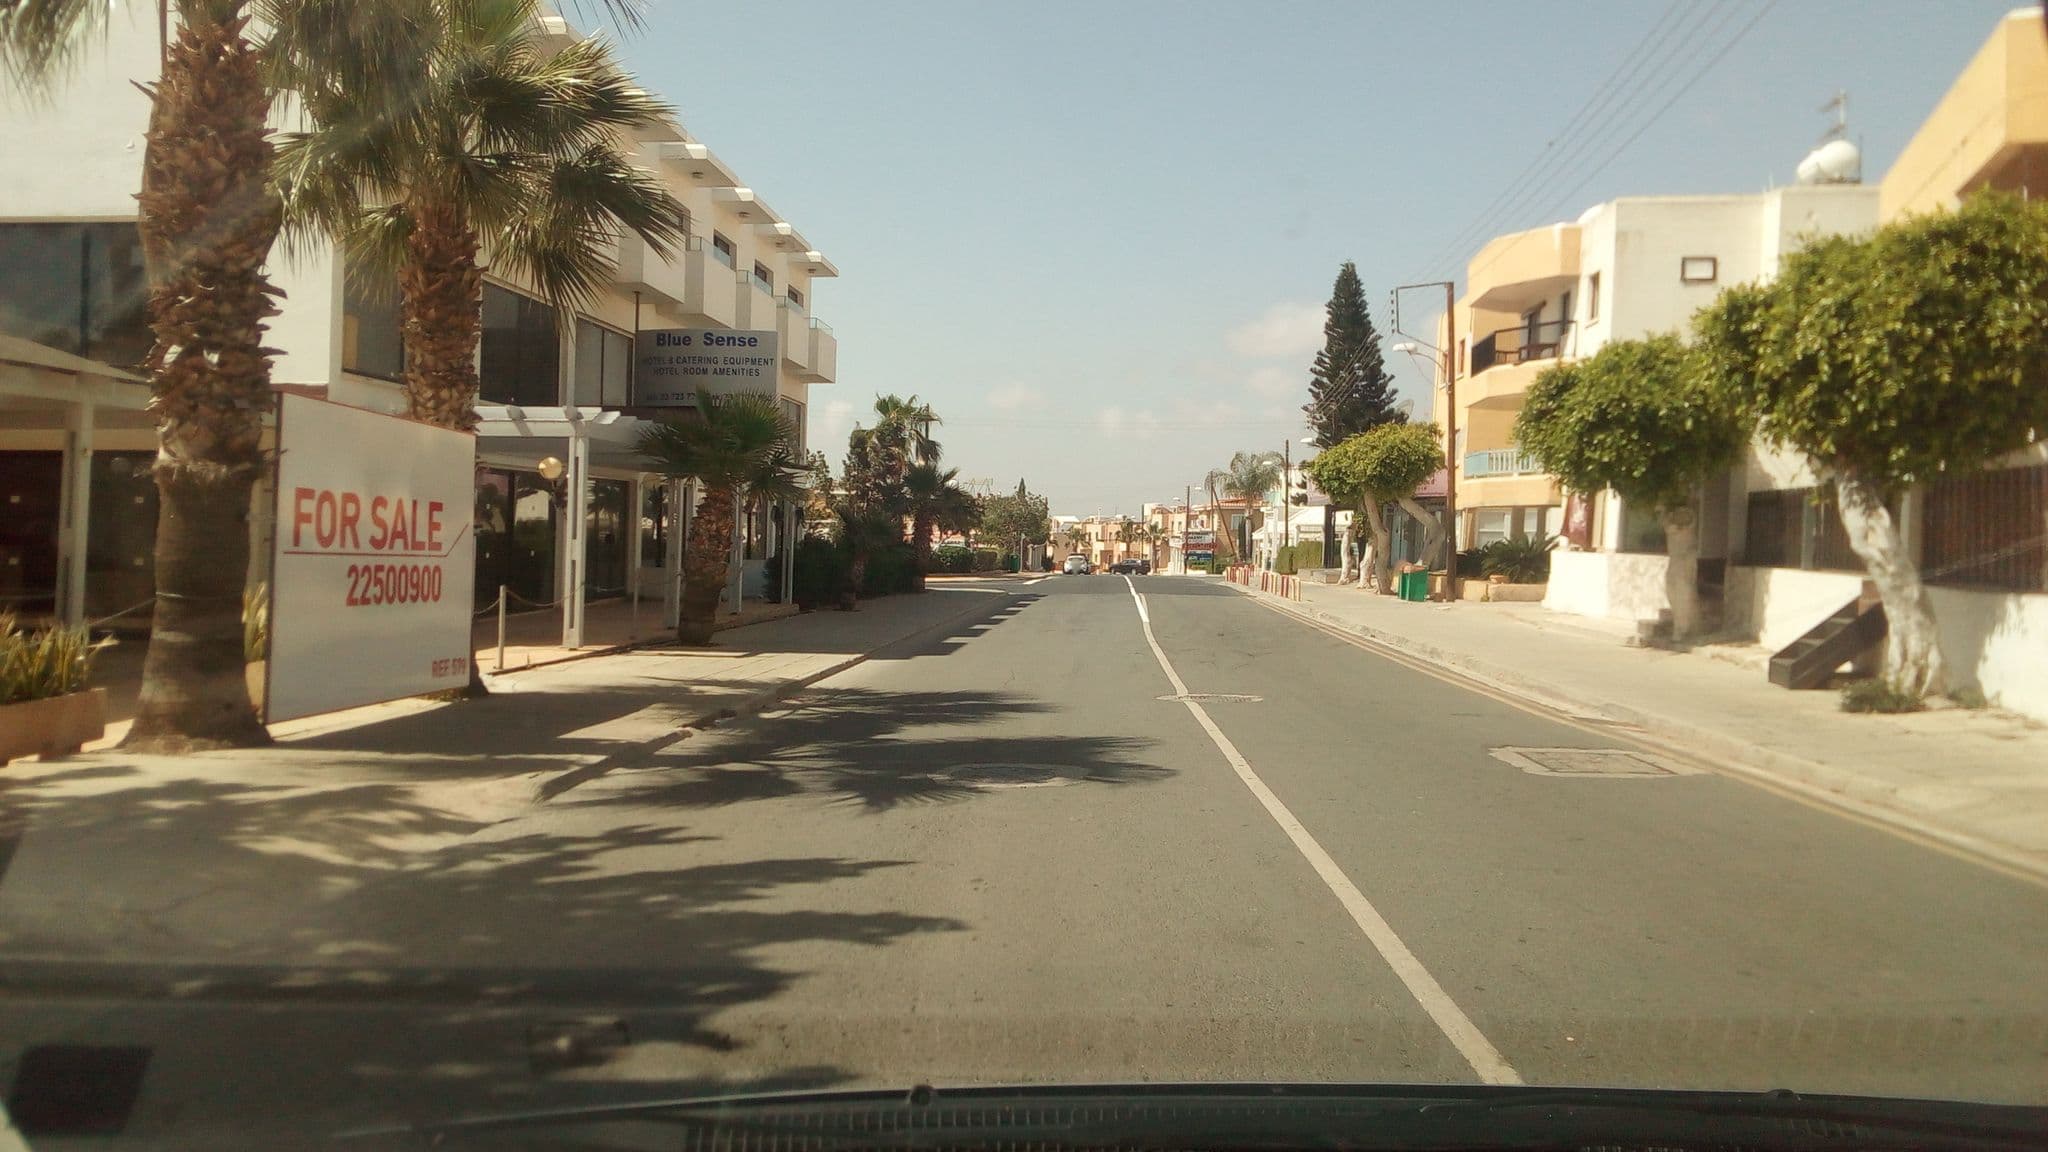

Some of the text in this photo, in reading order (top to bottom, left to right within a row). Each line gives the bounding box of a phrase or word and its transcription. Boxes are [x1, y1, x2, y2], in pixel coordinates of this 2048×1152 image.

[656, 332, 758, 347] Blue Sense
[676, 356, 719, 365] CATERING
[723, 357, 774, 366] EQUIPMENT
[682, 367, 708, 376] ROOM
[712, 367, 761, 377] AMENITIES
[293, 487, 443, 552] FOR SALE
[346, 564, 442, 608] 22500900
